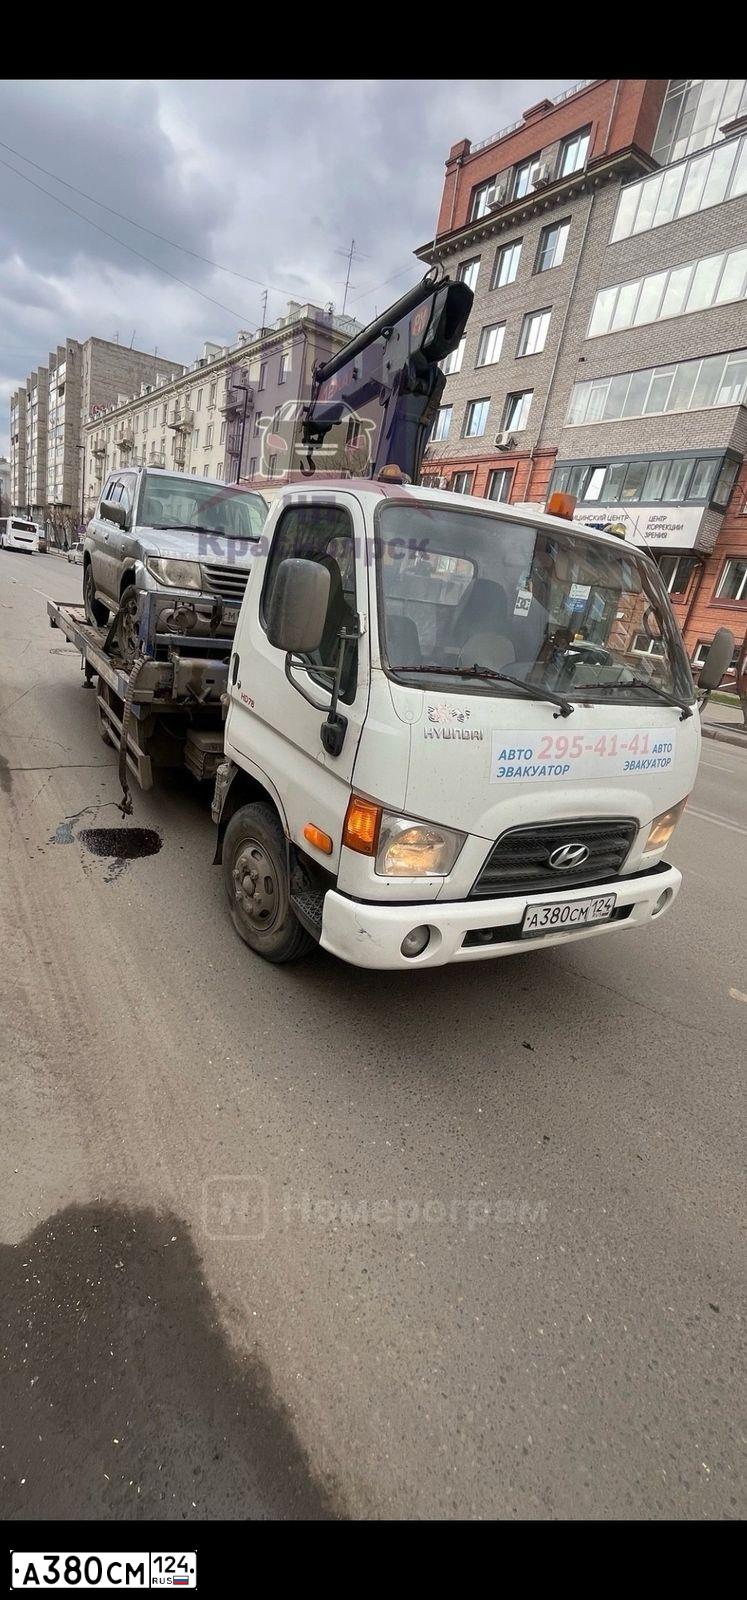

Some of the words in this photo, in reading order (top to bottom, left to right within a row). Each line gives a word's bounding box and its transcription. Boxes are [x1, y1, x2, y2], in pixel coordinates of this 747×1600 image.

[606, 514, 630, 522] ЦЕНТР
[648, 515, 668, 523] ЦЕНТР
[240, 692, 256, 709] HD78
[423, 727, 484, 741] HYUNDAI
[498, 749, 533, 761] АВТО
[537, 734, 650, 760] 295-41-41
[652, 743, 673, 754] АВТО
[496, 764, 570, 778] ЭВАКУАТОР
[623, 757, 672, 771] ЭВАКУАТОР
[591, 898, 611, 913] 124
